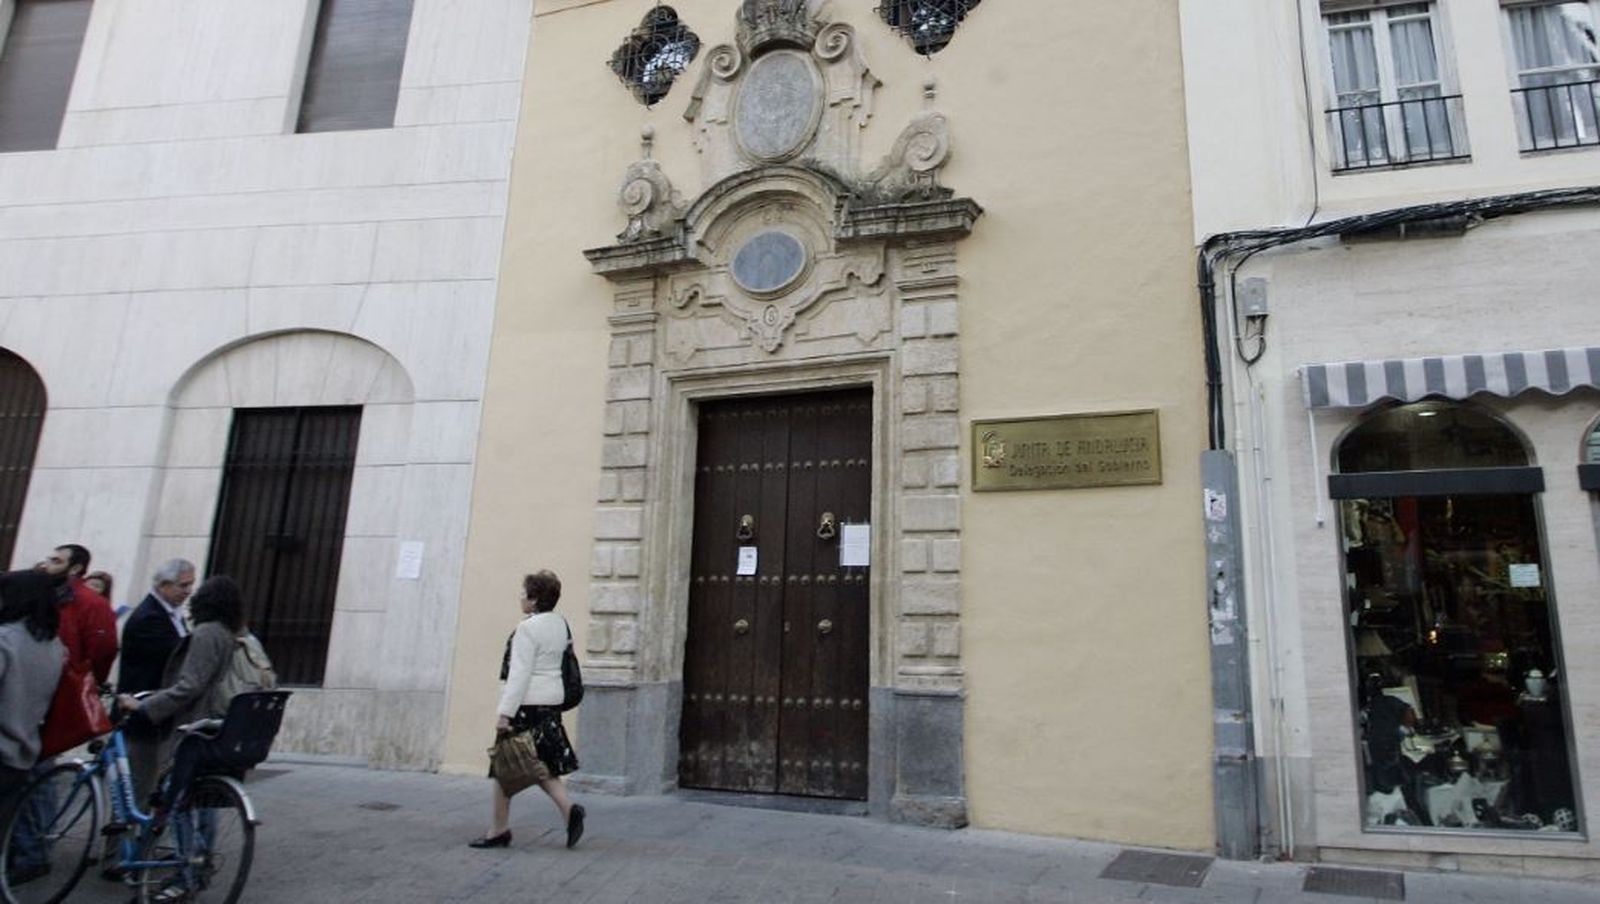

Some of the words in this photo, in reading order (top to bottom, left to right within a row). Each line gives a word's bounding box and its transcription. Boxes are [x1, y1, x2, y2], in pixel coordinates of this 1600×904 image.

[1010, 441, 1050, 459] JUNTA
[1055, 440, 1072, 457] DE
[1075, 460, 1093, 473] del
[1098, 459, 1151, 473] Gobierno
